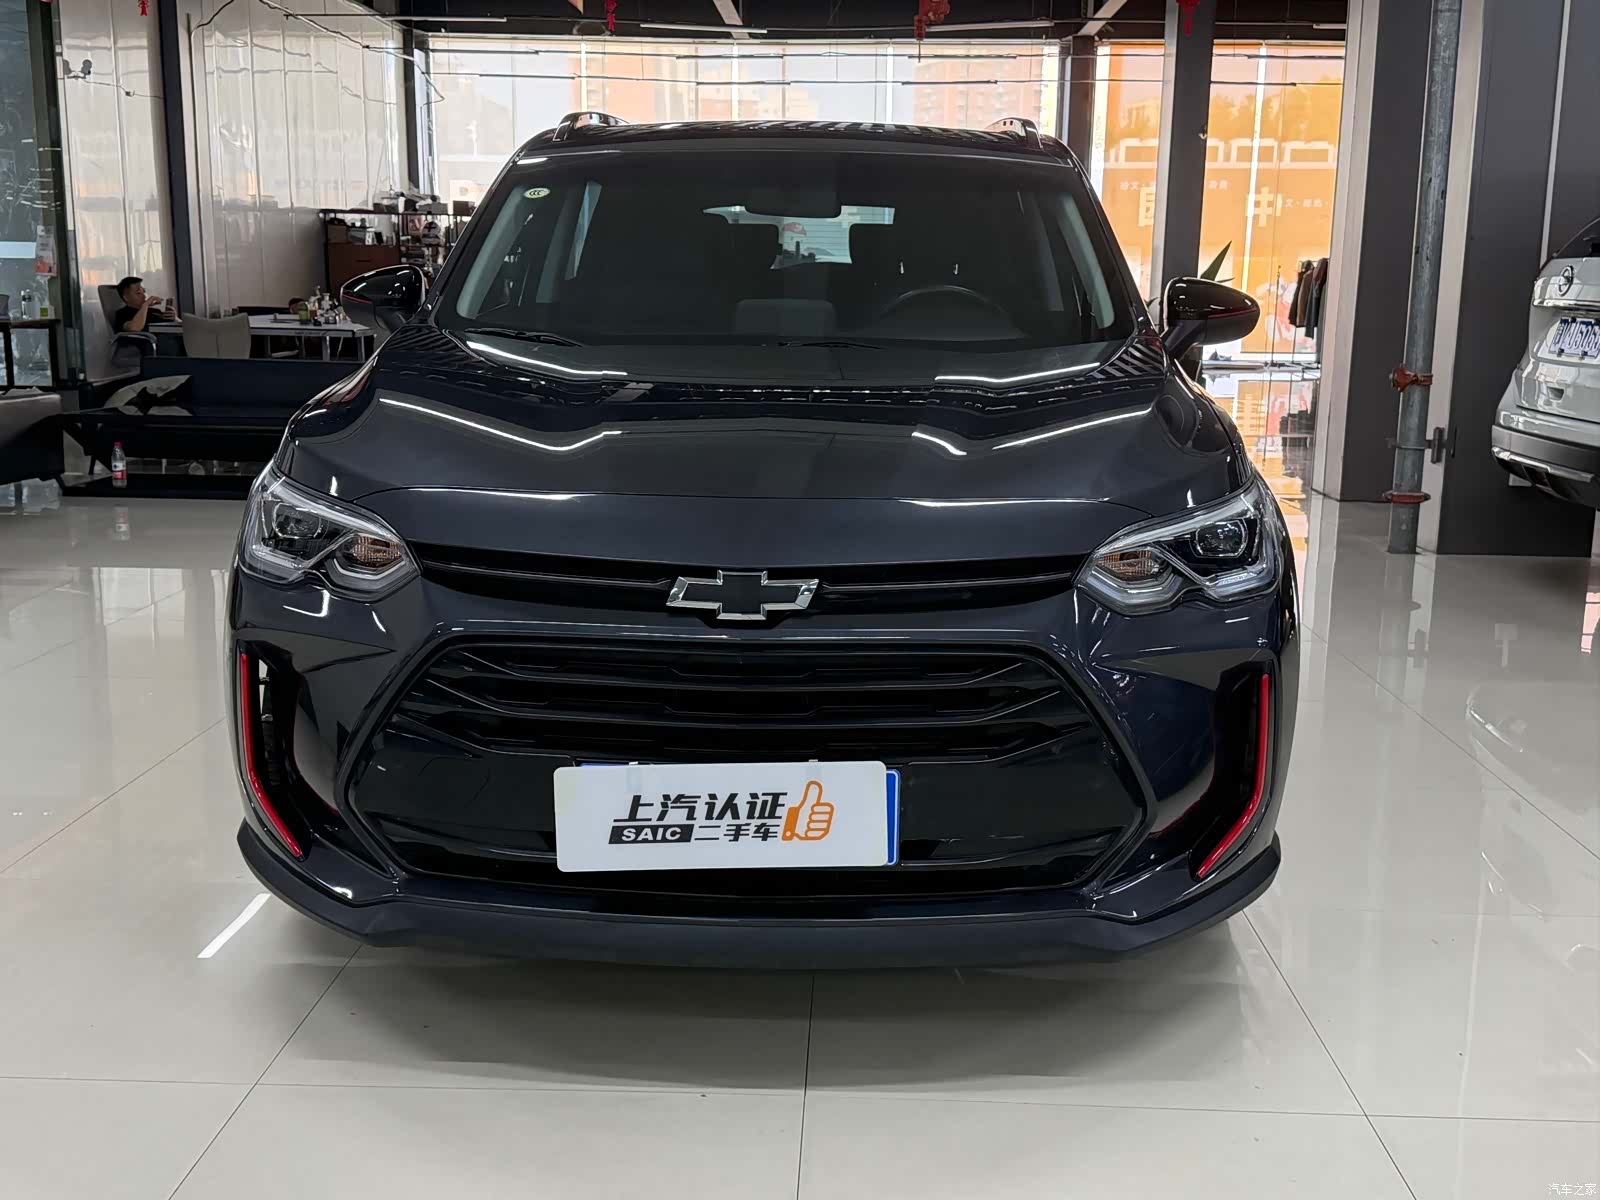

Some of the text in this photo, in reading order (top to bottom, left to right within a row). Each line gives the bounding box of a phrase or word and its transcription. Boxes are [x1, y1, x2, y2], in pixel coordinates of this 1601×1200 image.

[612, 791, 788, 823] 上汽认证
[621, 822, 781, 843] SAIC 二手车
